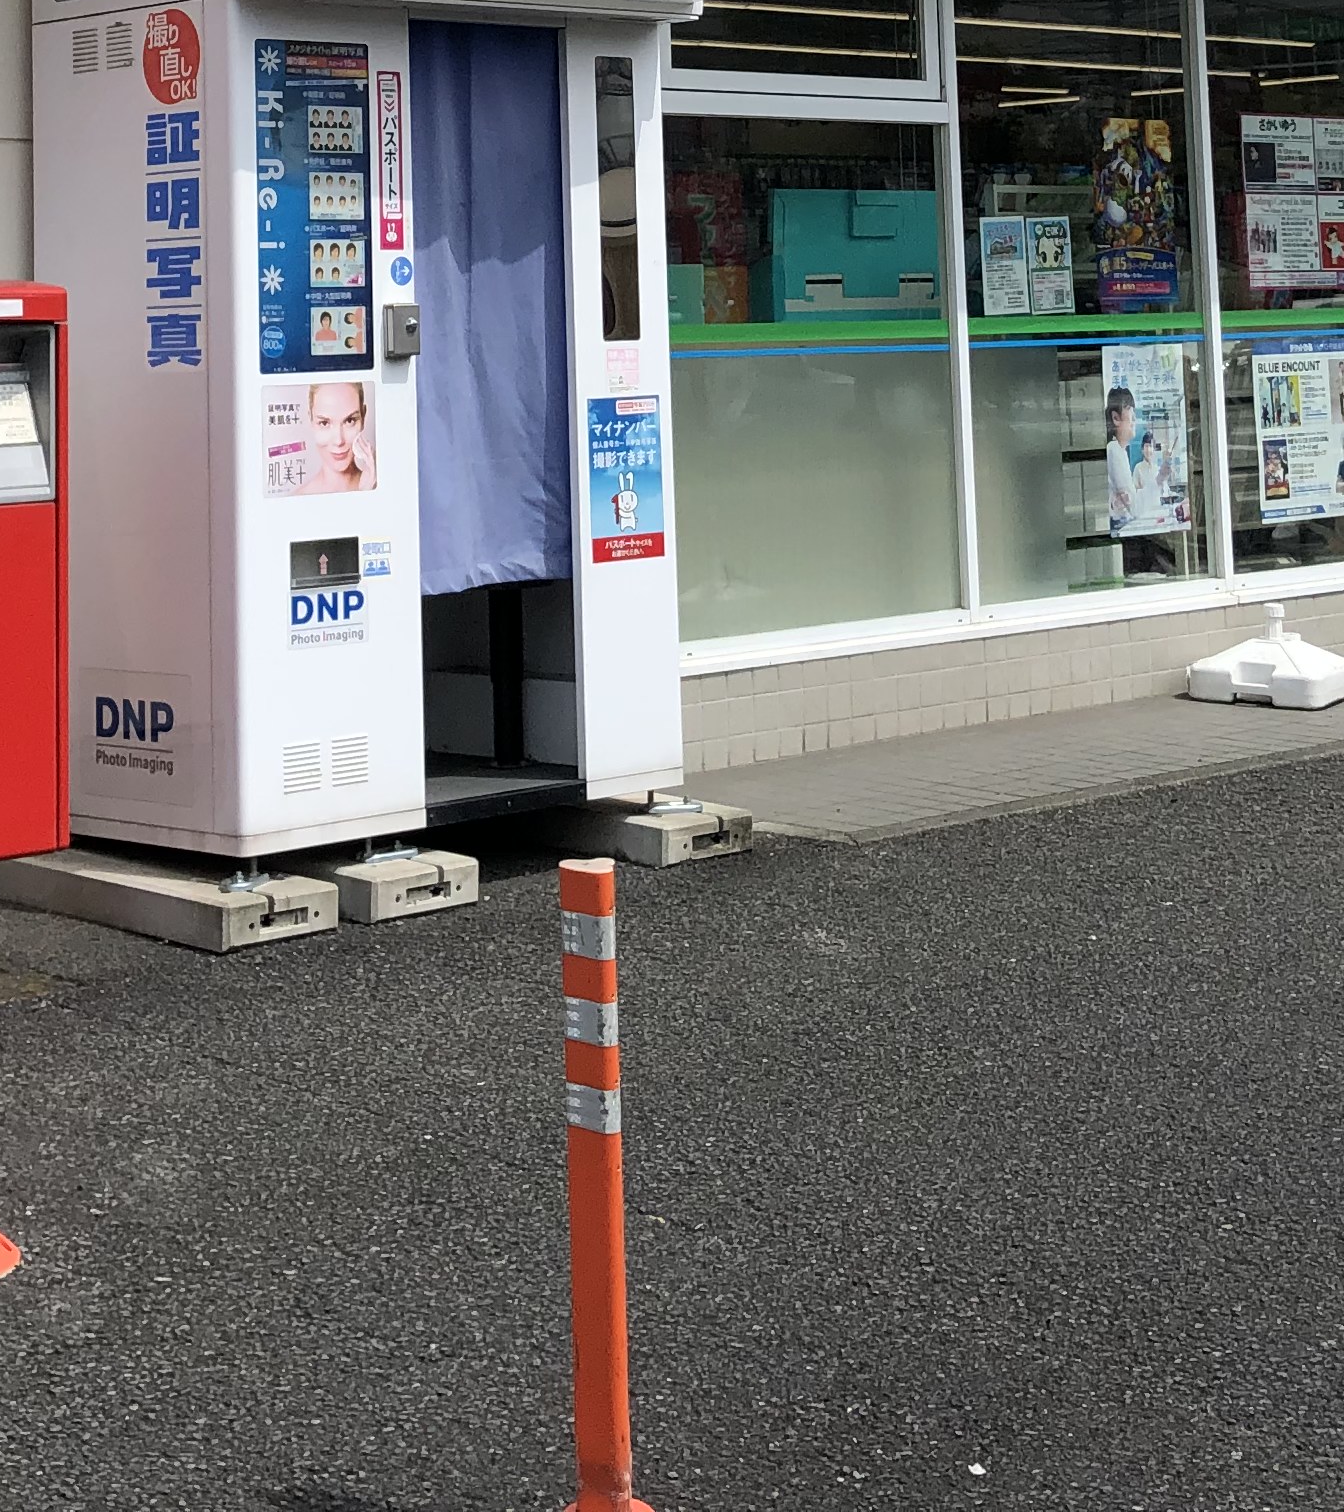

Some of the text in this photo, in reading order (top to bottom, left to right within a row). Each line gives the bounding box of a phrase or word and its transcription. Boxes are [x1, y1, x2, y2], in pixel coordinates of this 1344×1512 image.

[146, 13, 179, 50] 撮り
[159, 46, 193, 83] 直し
[170, 78, 198, 100] OK!
[1258, 118, 1297, 133] さかいゆう
[257, 90, 285, 250] Ki-Re-i
[145, 110, 203, 368] 証明写真
[1257, 360, 1321, 374] BLUE ENCOUNT
[591, 418, 657, 438] マイナンバー
[592, 448, 657, 470] 撮影できます
[290, 589, 365, 626] DNP
[290, 628, 364, 646] Photo Imaging
[95, 695, 174, 743] DNP
[95, 748, 174, 776] Photo Imaging
